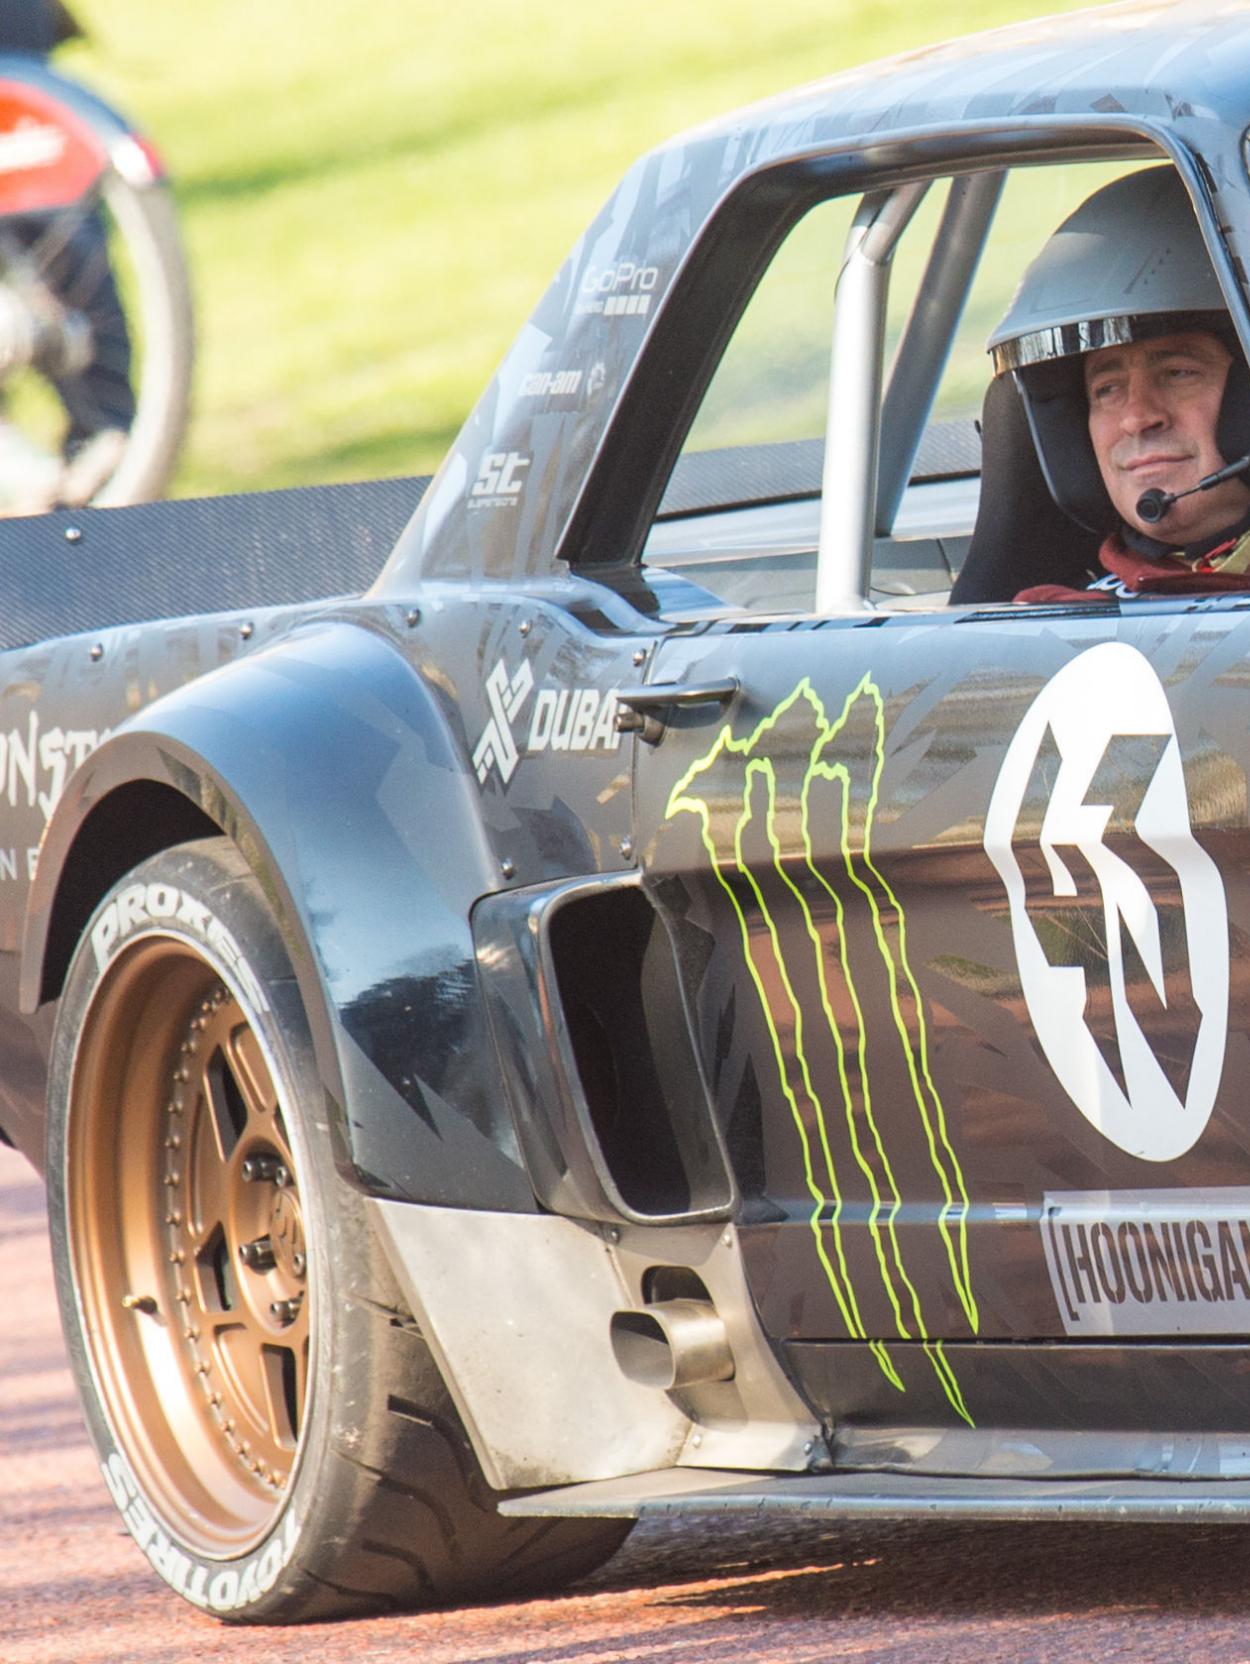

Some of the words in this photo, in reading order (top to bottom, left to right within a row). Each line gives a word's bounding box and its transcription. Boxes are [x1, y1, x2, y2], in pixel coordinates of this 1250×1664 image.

[581, 262, 658, 294] GoPro
[527, 688, 623, 750] DUBA
[0, 709, 112, 822] NST
[90, 881, 271, 1015] PROXES
